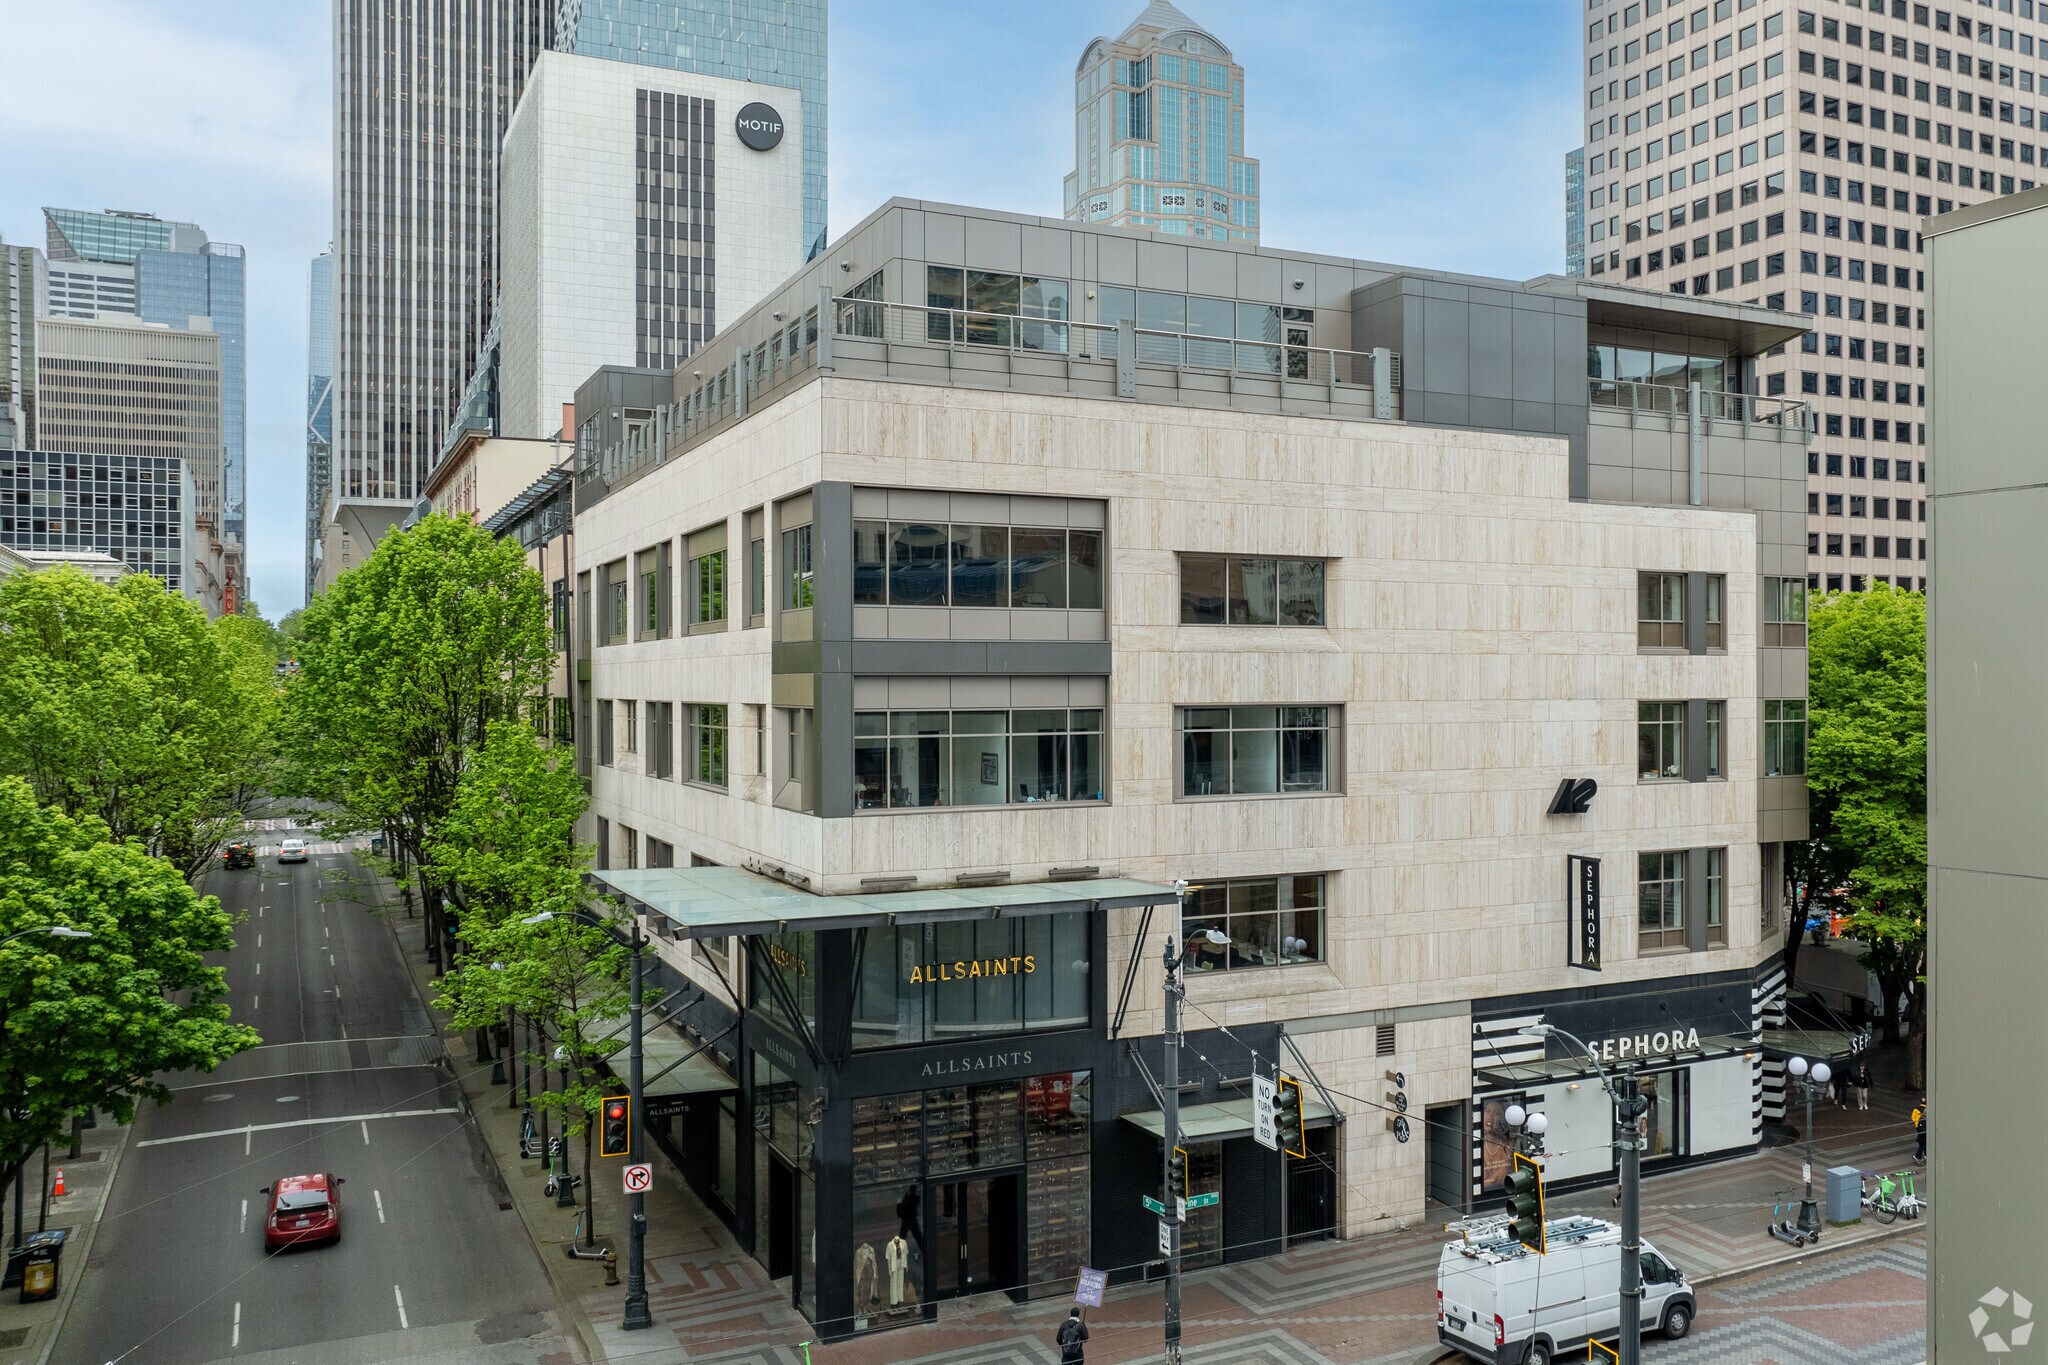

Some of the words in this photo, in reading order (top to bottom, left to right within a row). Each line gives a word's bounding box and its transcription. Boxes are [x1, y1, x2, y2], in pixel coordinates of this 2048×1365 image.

[739, 118, 781, 133] MOTIF
[1546, 777, 1597, 814] K2
[1587, 865, 1596, 963] SEPHORA
[909, 955, 1036, 984] ALLSAINTS
[1588, 1027, 1700, 1062] SEPHORA
[921, 1050, 1032, 1076] ALLSAINTS
[1259, 1085, 1270, 1100] NO
[650, 1106, 689, 1115] ALLSAINTS
[1257, 1099, 1272, 1114] TURN
[1260, 1114, 1269, 1126] ON
[1260, 1127, 1271, 1140] RED
[1187, 1199, 1198, 1208] ine
[1160, 1224, 1169, 1236] ONE
[1160, 1233, 1169, 1243] WAY
